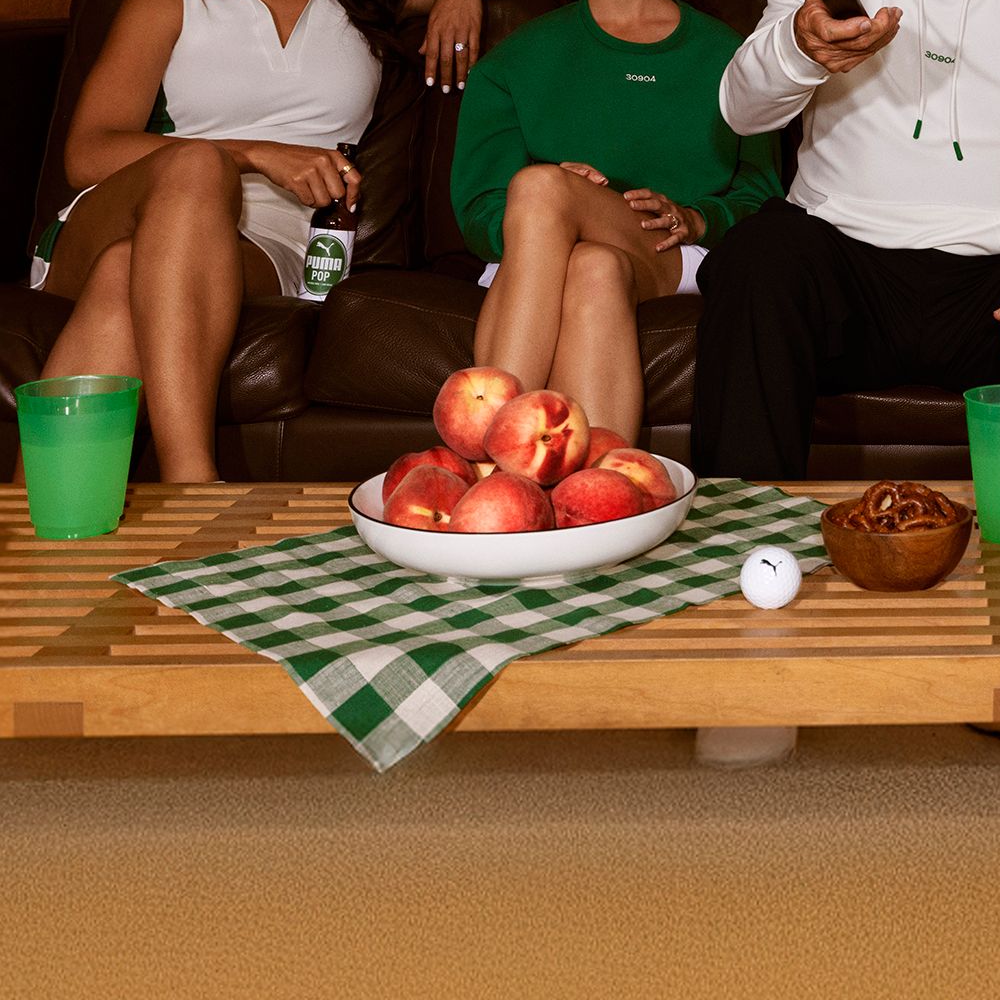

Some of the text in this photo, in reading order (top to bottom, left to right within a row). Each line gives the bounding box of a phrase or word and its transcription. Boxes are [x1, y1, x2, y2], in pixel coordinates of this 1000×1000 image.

[625, 73, 656, 82] 30904
[306, 255, 343, 271] PUMA
[311, 270, 331, 282] POP
